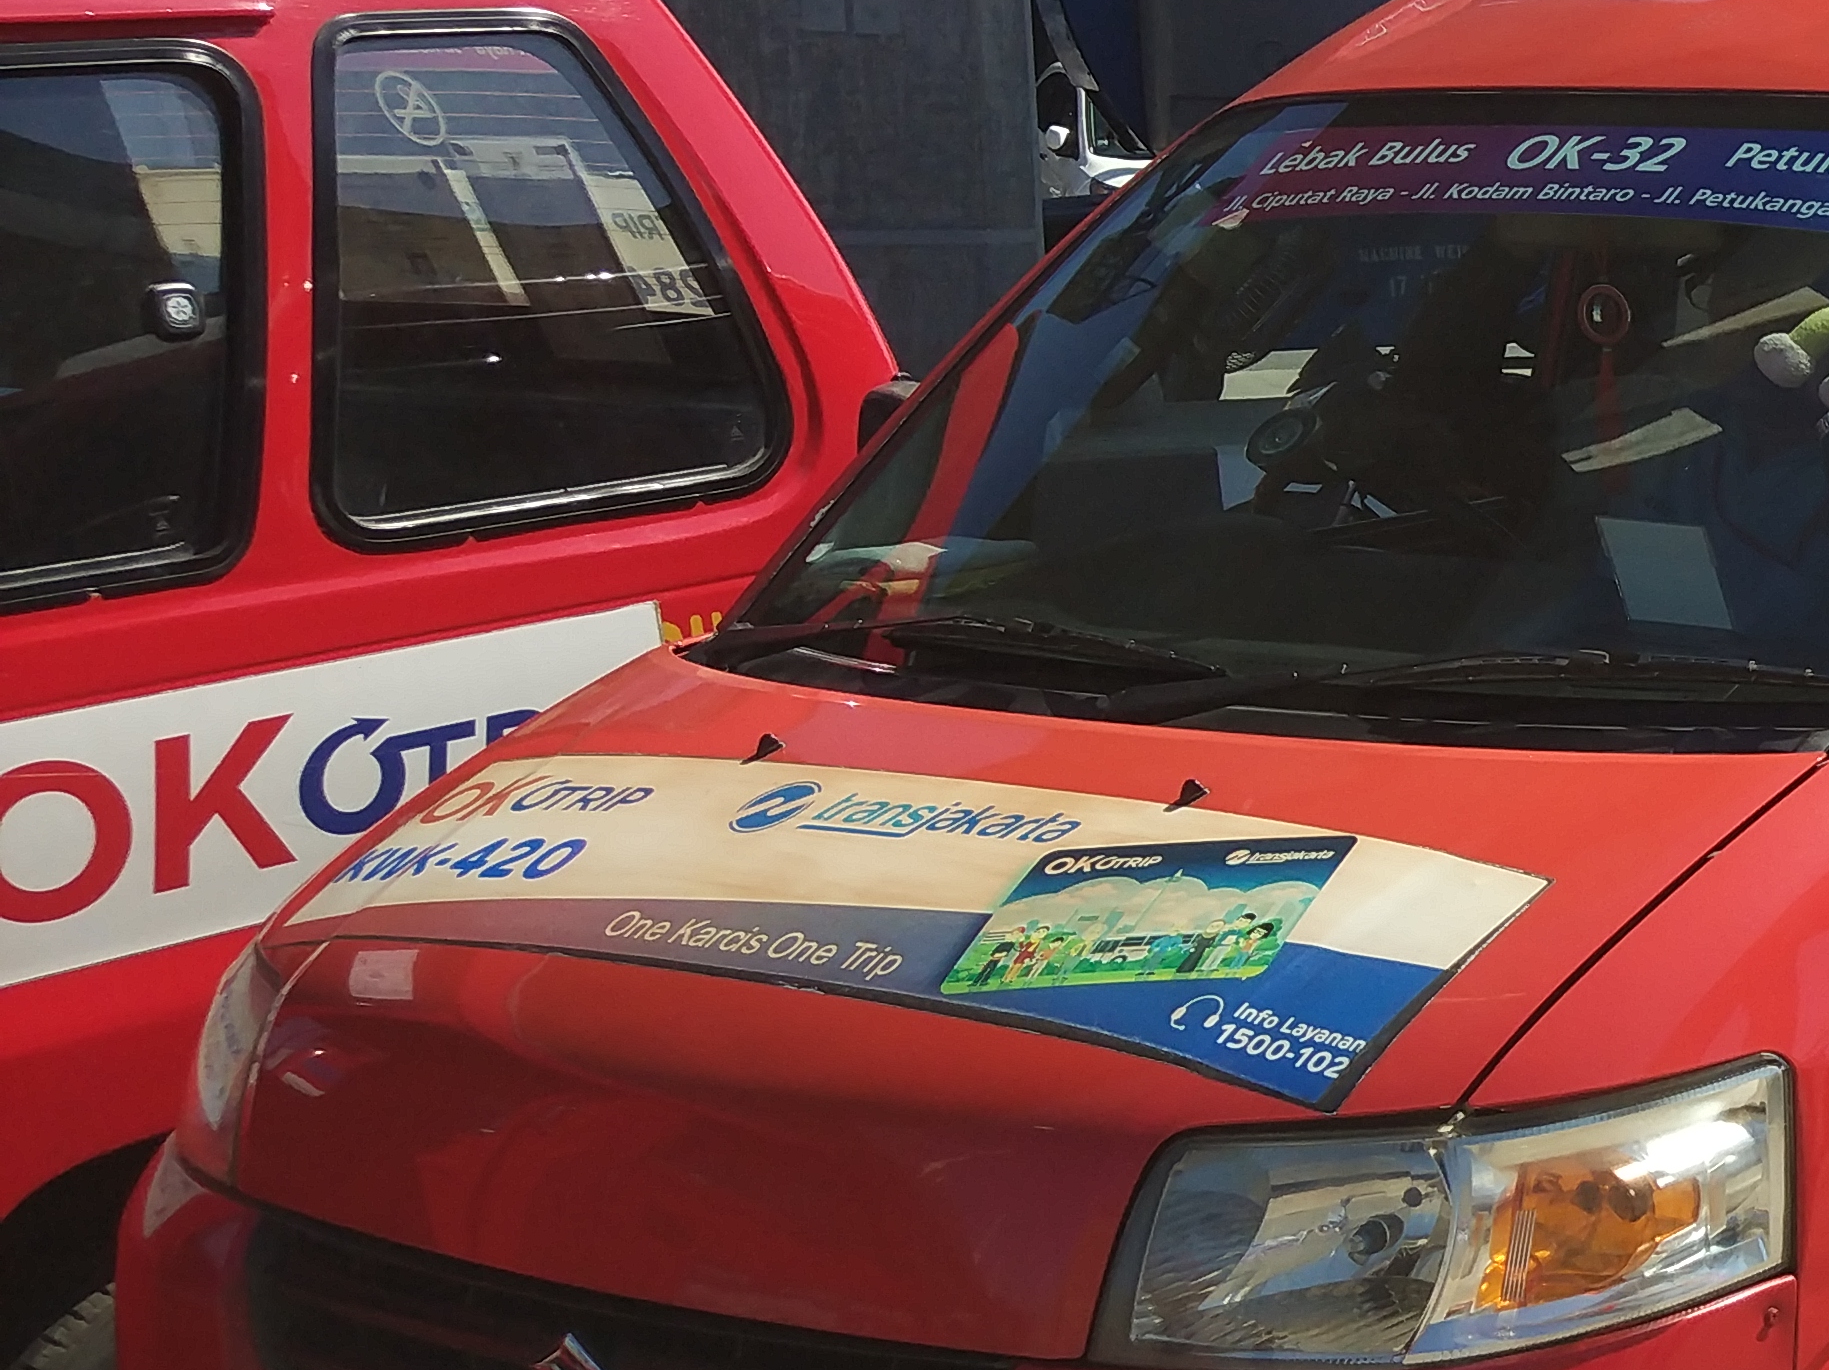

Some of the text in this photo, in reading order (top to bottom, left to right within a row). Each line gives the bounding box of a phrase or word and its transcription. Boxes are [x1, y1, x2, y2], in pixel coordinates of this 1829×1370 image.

[1260, 140, 1369, 176] Lebak
[1368, 137, 1477, 167] Bulus
[1506, 135, 1687, 172] OK-32
[1251, 185, 1336, 212] Ciputat
[1340, 185, 1395, 206] Raya
[1411, 182, 1437, 200] Jl.
[1443, 182, 1535, 202] Kodam
[1536, 183, 1635, 203] Bintaro
[1653, 187, 1681, 205] Jl.
[816, 792, 1083, 844] transjakarta
[332, 837, 588, 884] KWK-420
[604, 910, 904, 981] One Karcis One Trip
[1216, 1022, 1352, 1080] 1500-102
[1234, 1001, 1367, 1053] Info Layanan
